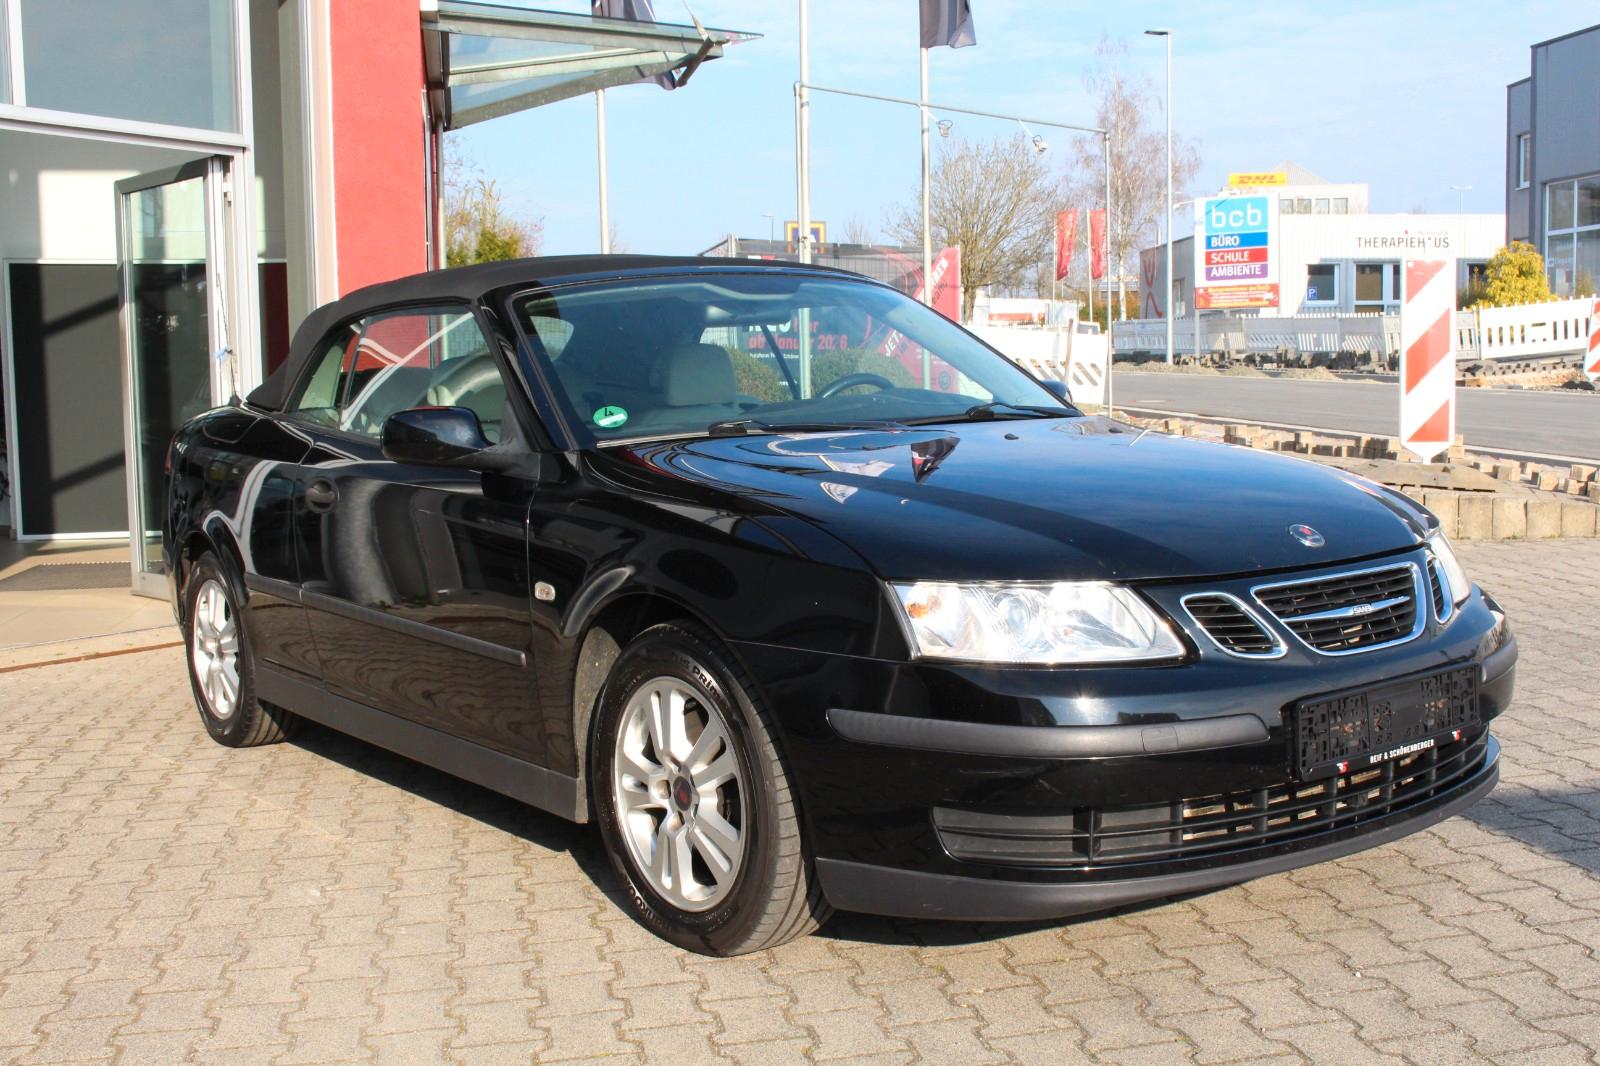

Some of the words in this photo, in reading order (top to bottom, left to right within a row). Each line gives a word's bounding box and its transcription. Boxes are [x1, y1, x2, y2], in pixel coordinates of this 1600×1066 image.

[1238, 175, 1278, 184] DHL
[1210, 203, 1263, 229] bcb
[1210, 234, 1240, 248] BÜRO
[1356, 237, 1450, 249] THERAPIEHUS
[1210, 250, 1250, 264] SCHULE
[1210, 264, 1262, 278] AMBIENTE
